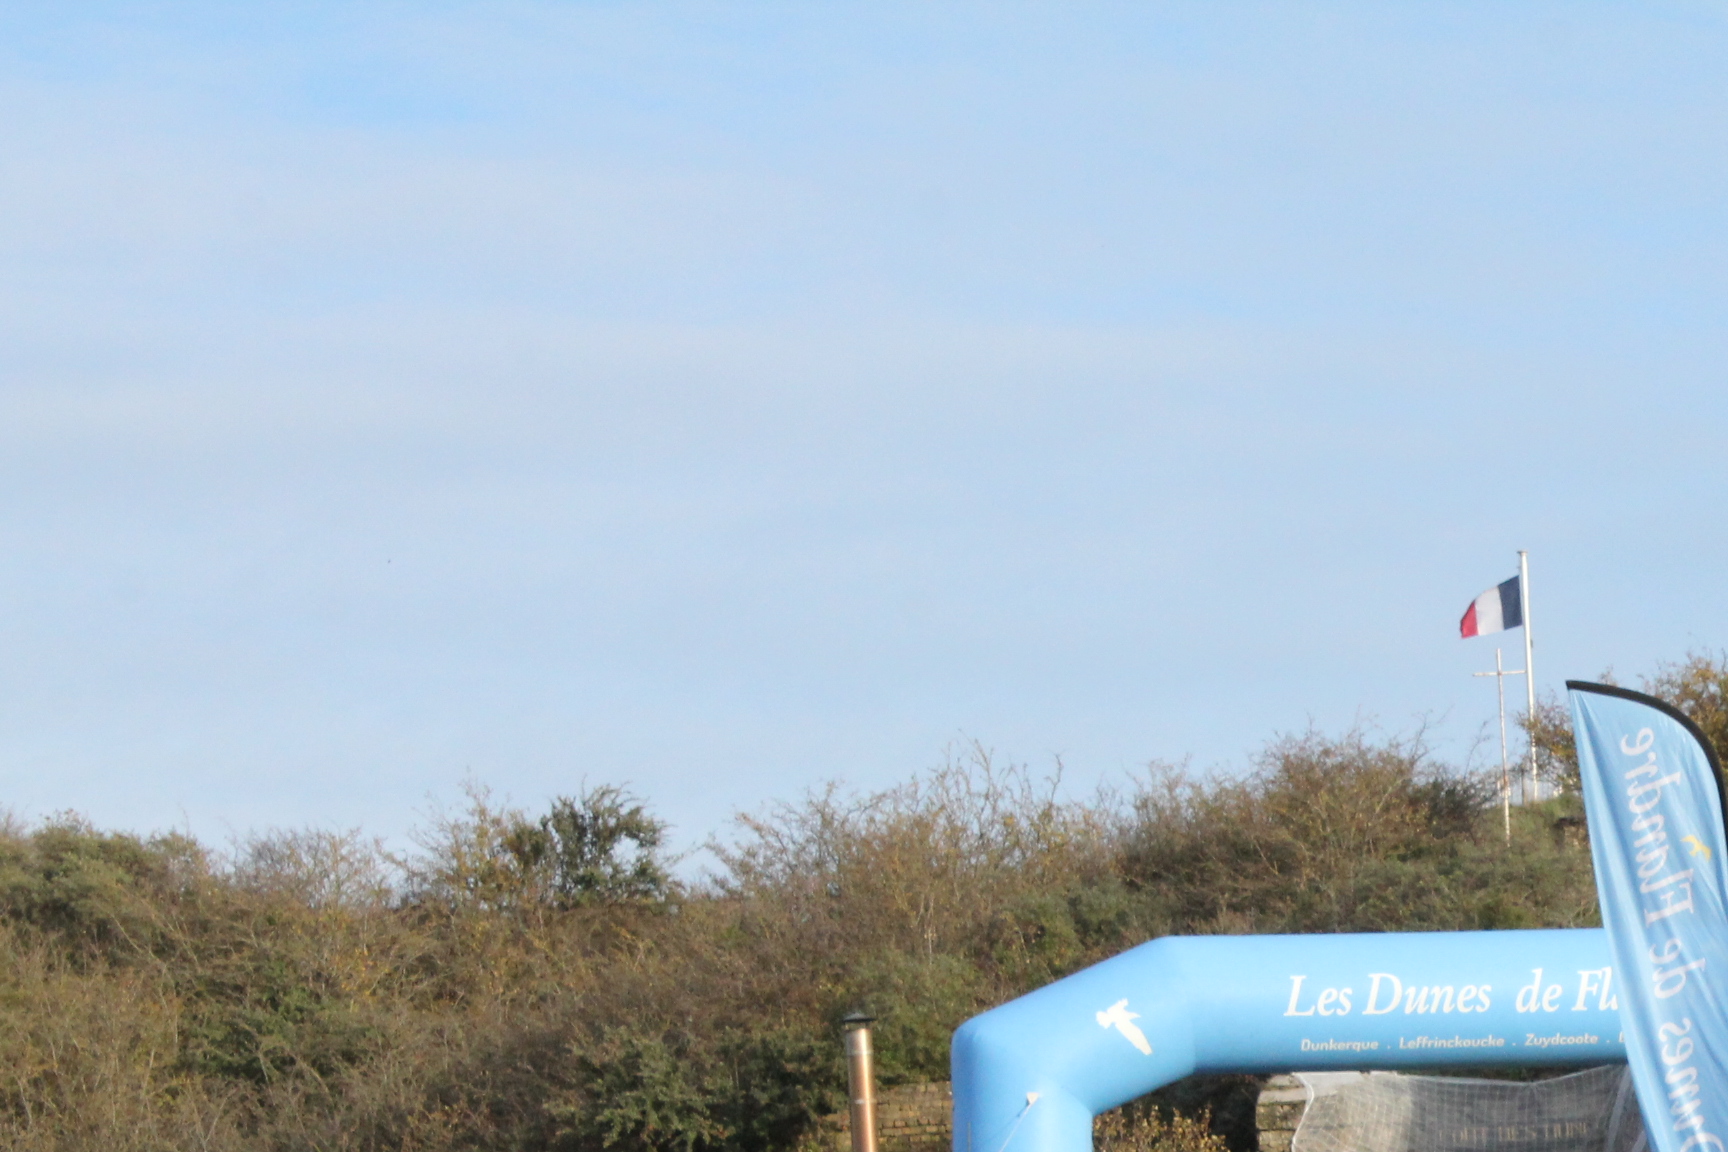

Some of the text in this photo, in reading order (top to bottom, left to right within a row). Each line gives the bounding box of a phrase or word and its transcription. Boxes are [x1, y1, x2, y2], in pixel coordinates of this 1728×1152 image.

[1283, 974, 1354, 1017] Les
[1361, 971, 1493, 1016] Dunes
[1514, 967, 1563, 1013] de
[1300, 1031, 1598, 1052] Dunkerque Leffrinckoucke Zuydcoote
